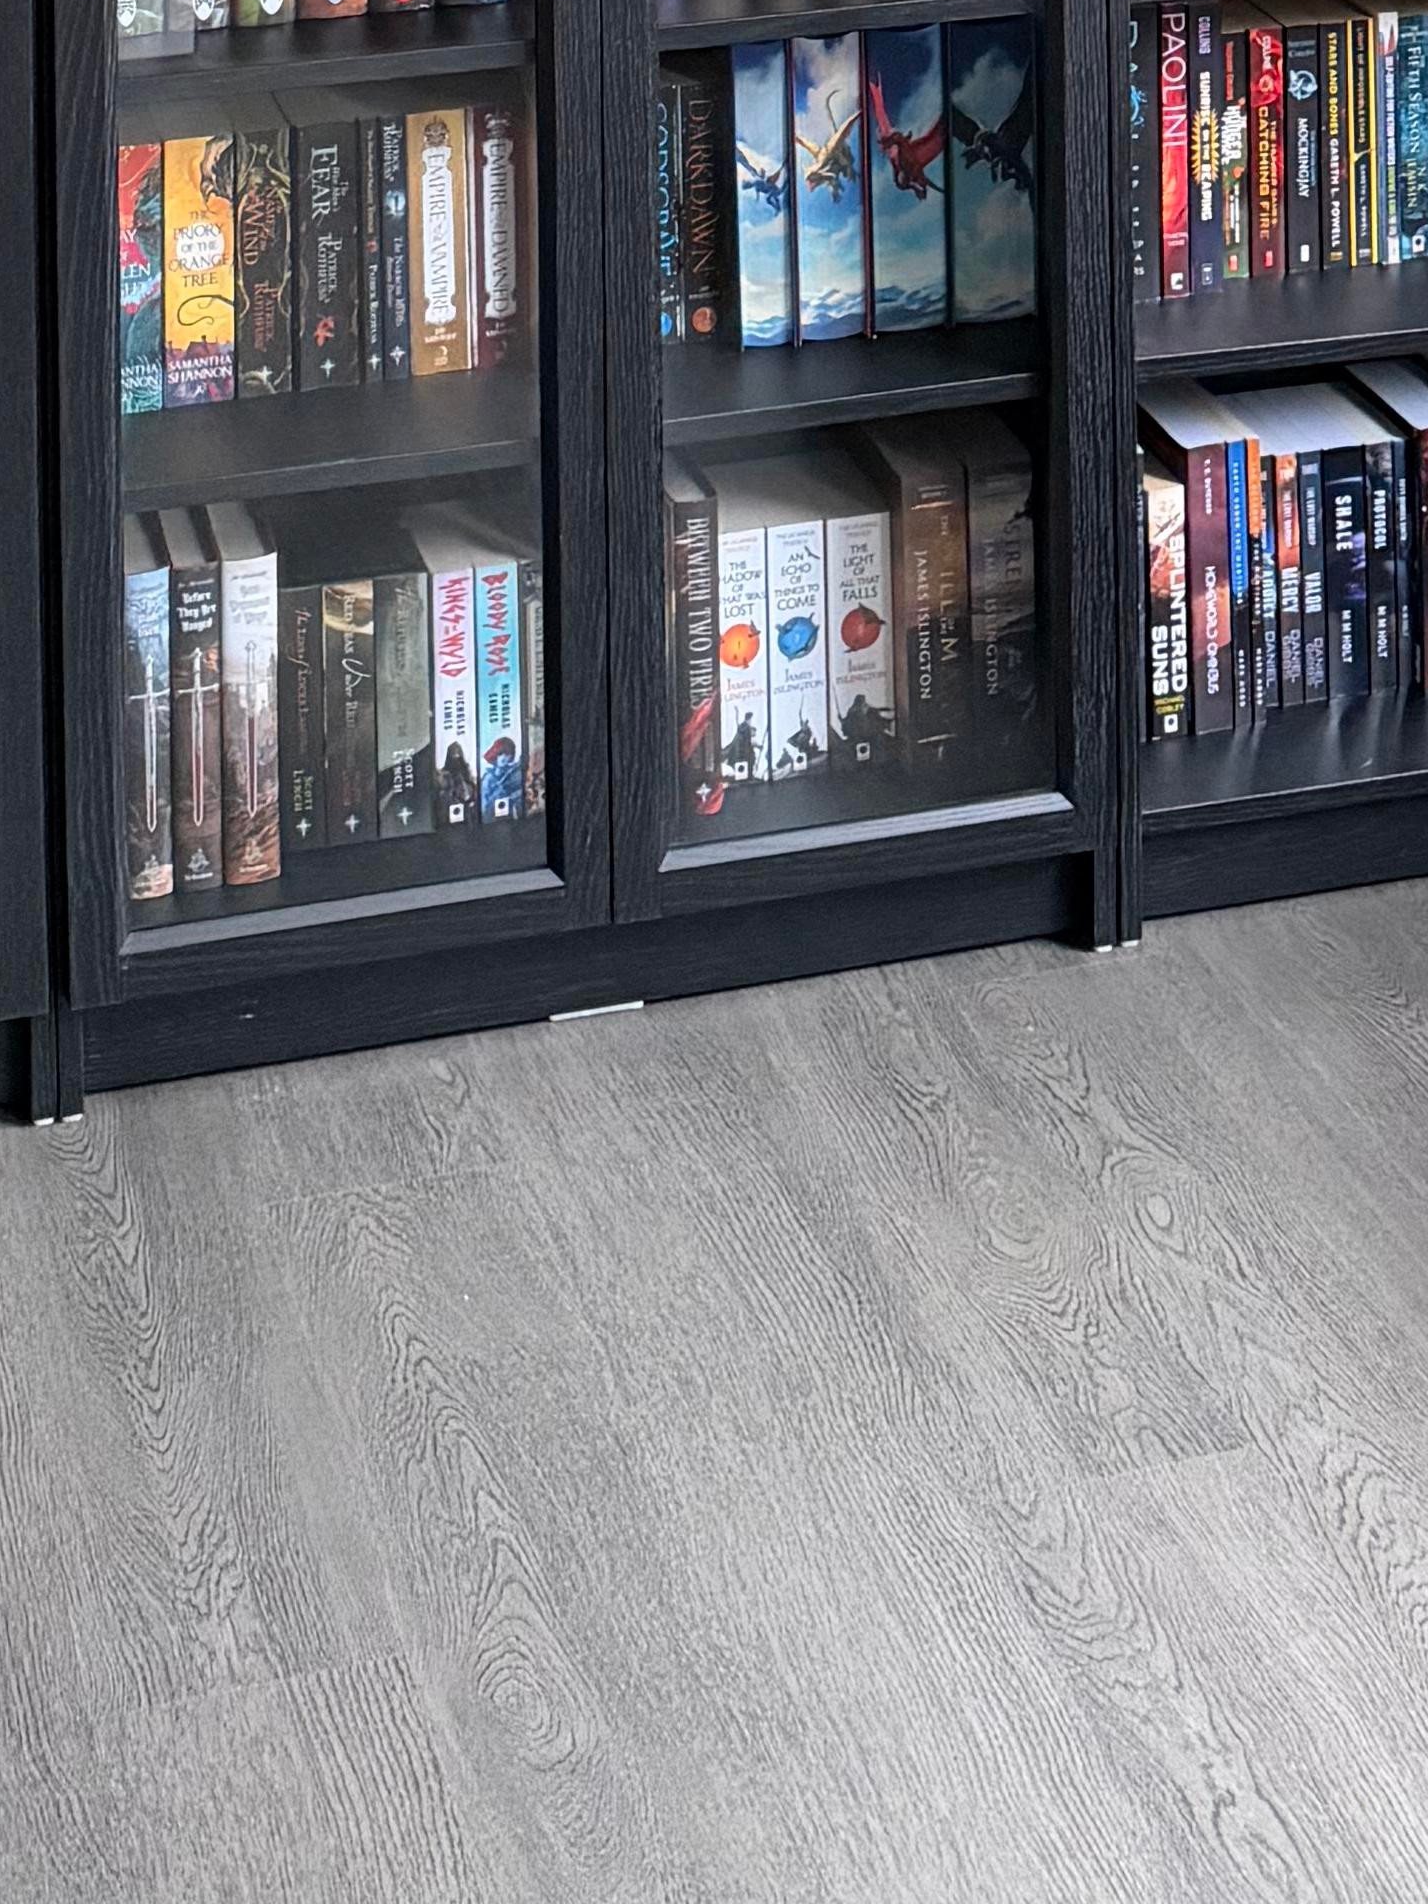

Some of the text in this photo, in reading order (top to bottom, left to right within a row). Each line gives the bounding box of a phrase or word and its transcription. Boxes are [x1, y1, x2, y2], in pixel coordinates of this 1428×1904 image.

[1162, 13, 1187, 147] PAOLINI
[687, 99, 717, 274] DARKDAWN
[1260, 198, 1269, 240] FIRE
[182, 272, 218, 286] TREE
[168, 367, 232, 385] SHANNON
[1336, 495, 1352, 551] SHALE
[690, 606, 712, 652] TWO
[1170, 535, 1188, 692] SPLINTERED
[1151, 625, 1169, 695] SUNS
